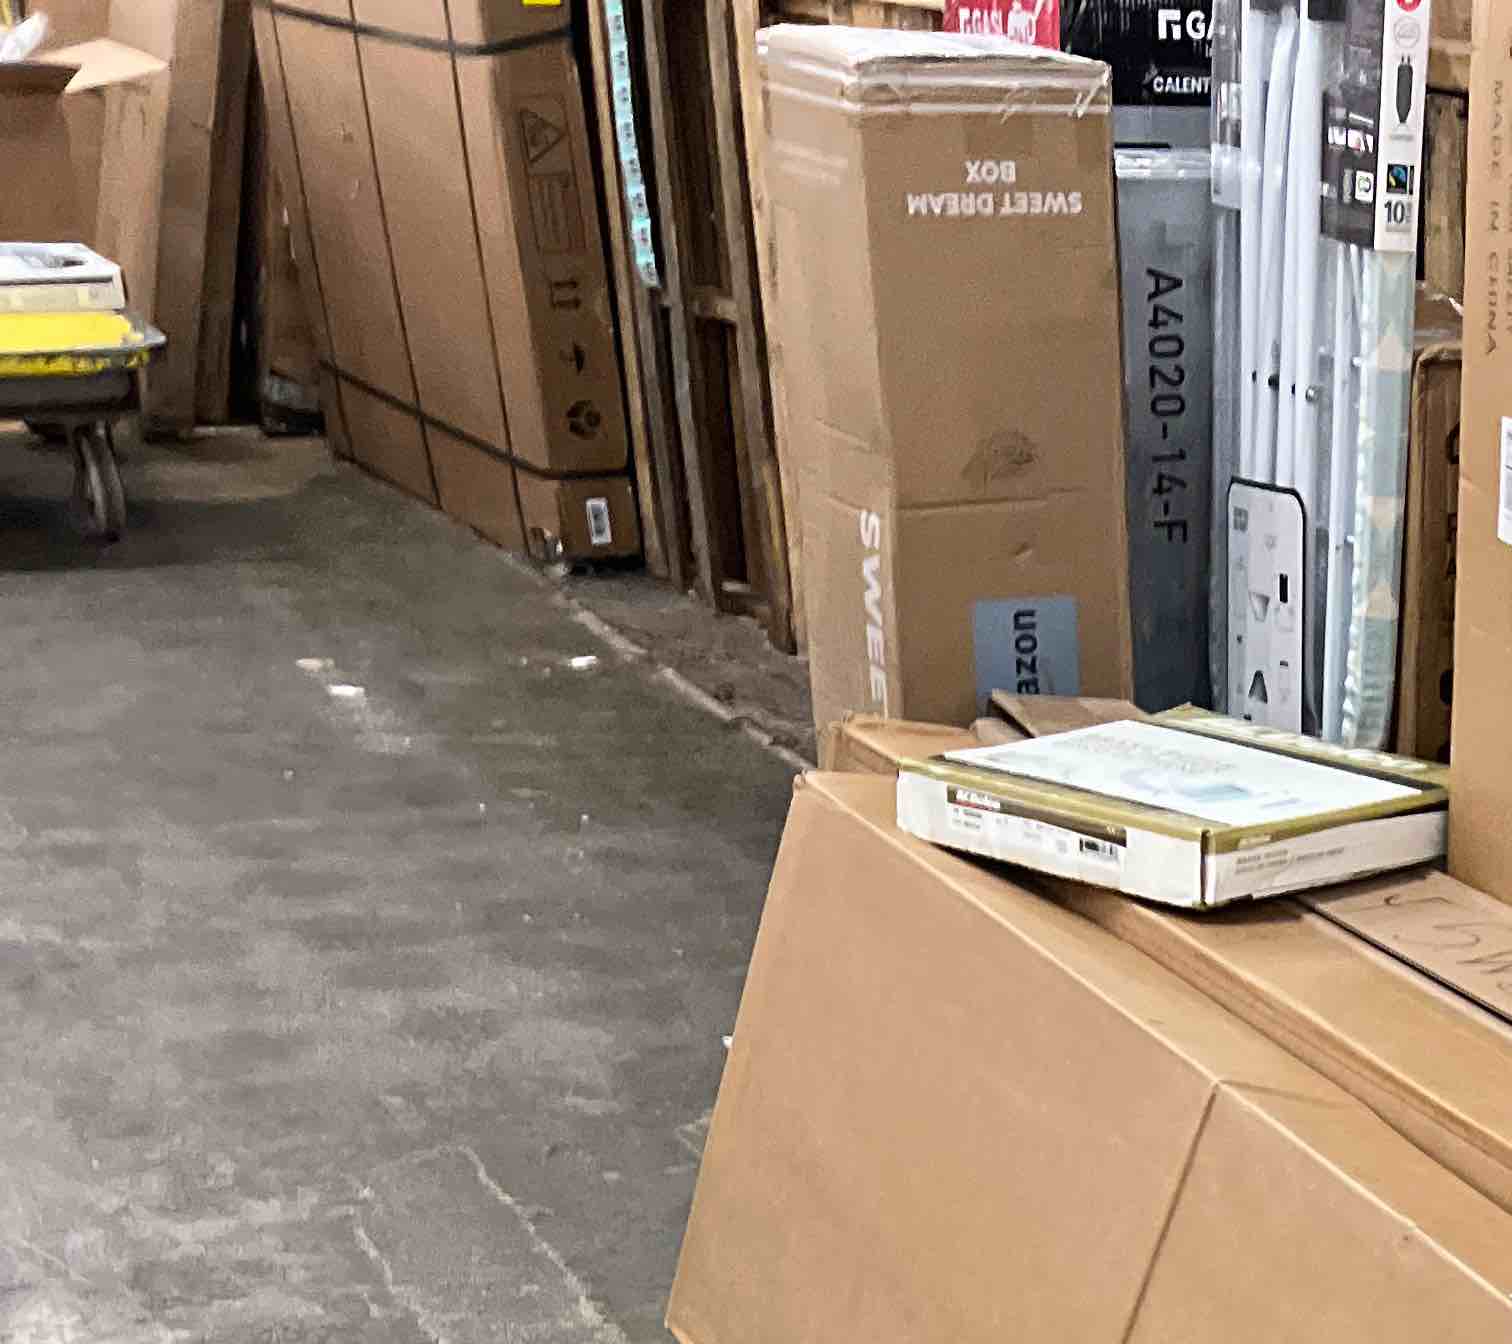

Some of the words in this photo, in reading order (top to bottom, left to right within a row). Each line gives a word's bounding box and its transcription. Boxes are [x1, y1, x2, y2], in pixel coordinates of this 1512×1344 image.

[964, 159, 1016, 184] BOX
[1488, 79, 1504, 181] MADE
[906, 192, 994, 216] DREAM
[1000, 191, 1084, 215] SWEET
[1486, 200, 1501, 233] IN
[1484, 251, 1500, 357] CHINA
[1146, 268, 1188, 544] A4020-14-F
[859, 511, 888, 717] SWEE
[1013, 608, 1041, 695] azon
